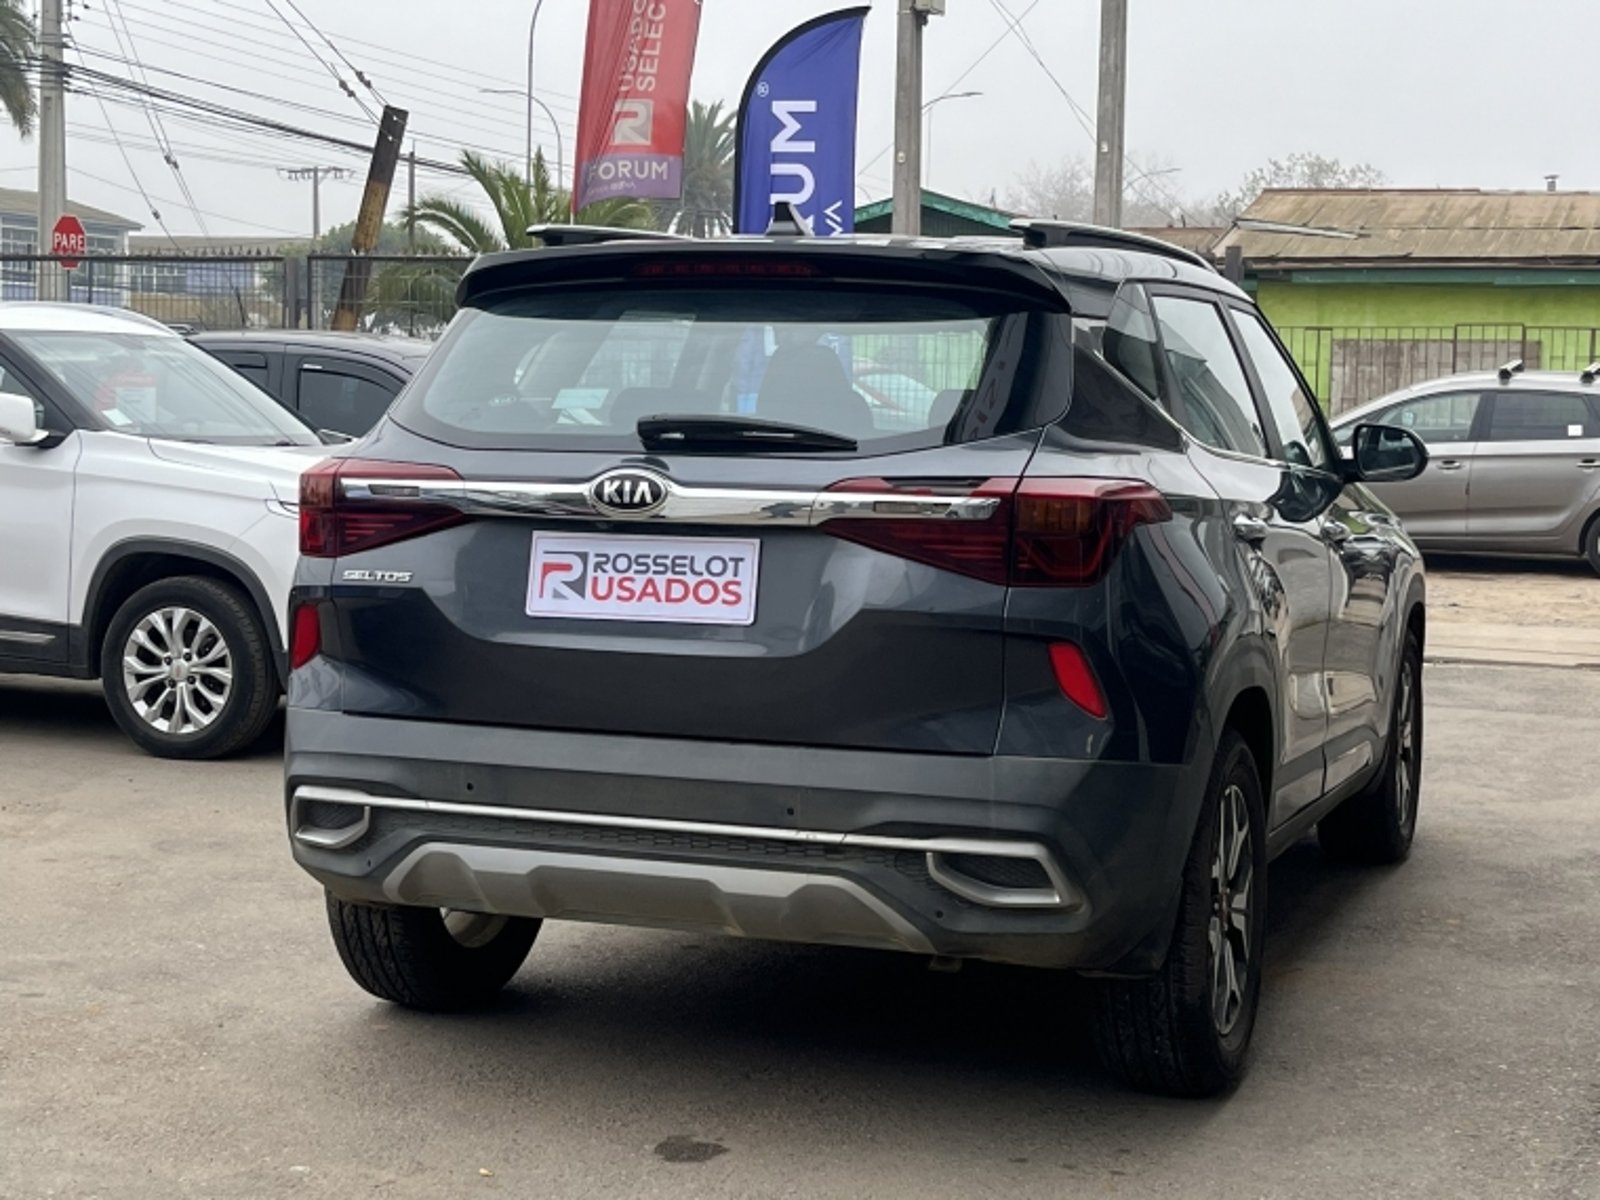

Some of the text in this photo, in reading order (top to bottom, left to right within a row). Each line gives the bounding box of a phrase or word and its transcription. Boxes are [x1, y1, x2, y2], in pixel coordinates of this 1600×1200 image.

[54, 233, 84, 251] PARE
[603, 480, 653, 504] KIA
[342, 570, 413, 582] SELTOS
[593, 553, 745, 577] ROSSELOT
[591, 576, 743, 606] USADOS
